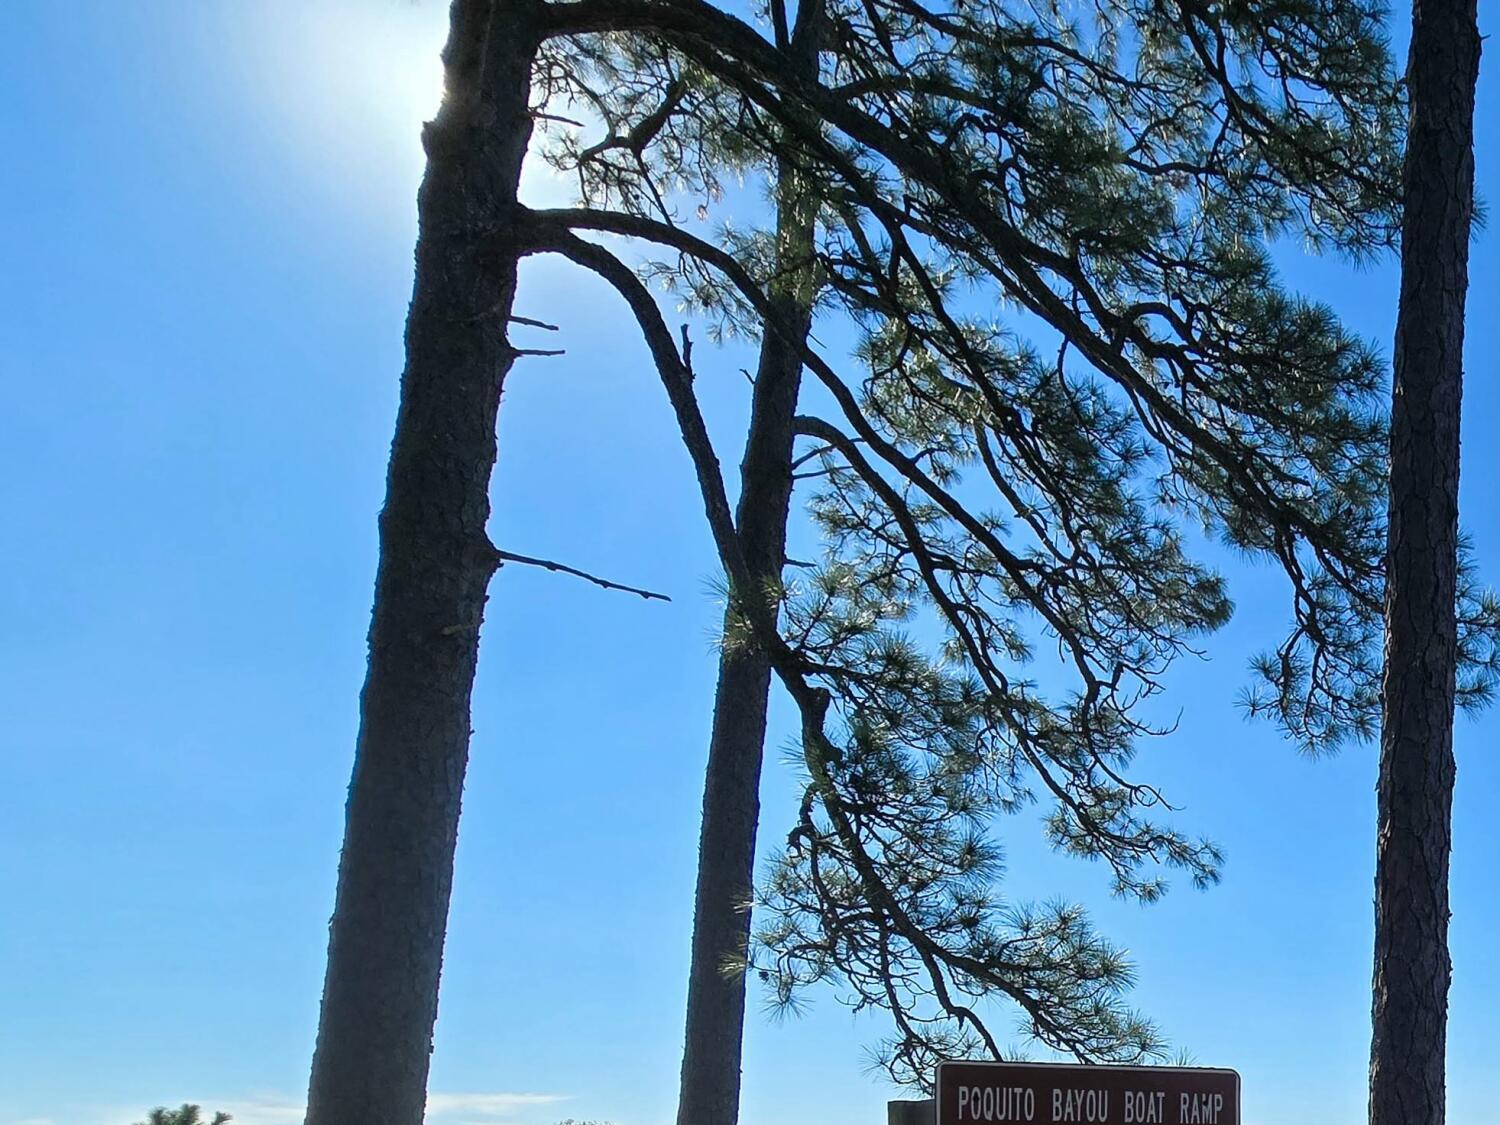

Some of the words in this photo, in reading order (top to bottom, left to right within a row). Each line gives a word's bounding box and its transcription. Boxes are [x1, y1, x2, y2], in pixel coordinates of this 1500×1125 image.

[958, 1086, 1035, 1121] POQUITO
[1052, 1088, 1108, 1123] BAYOU
[1124, 1091, 1166, 1124] BOAT
[1180, 1092, 1223, 1125] RAMP
